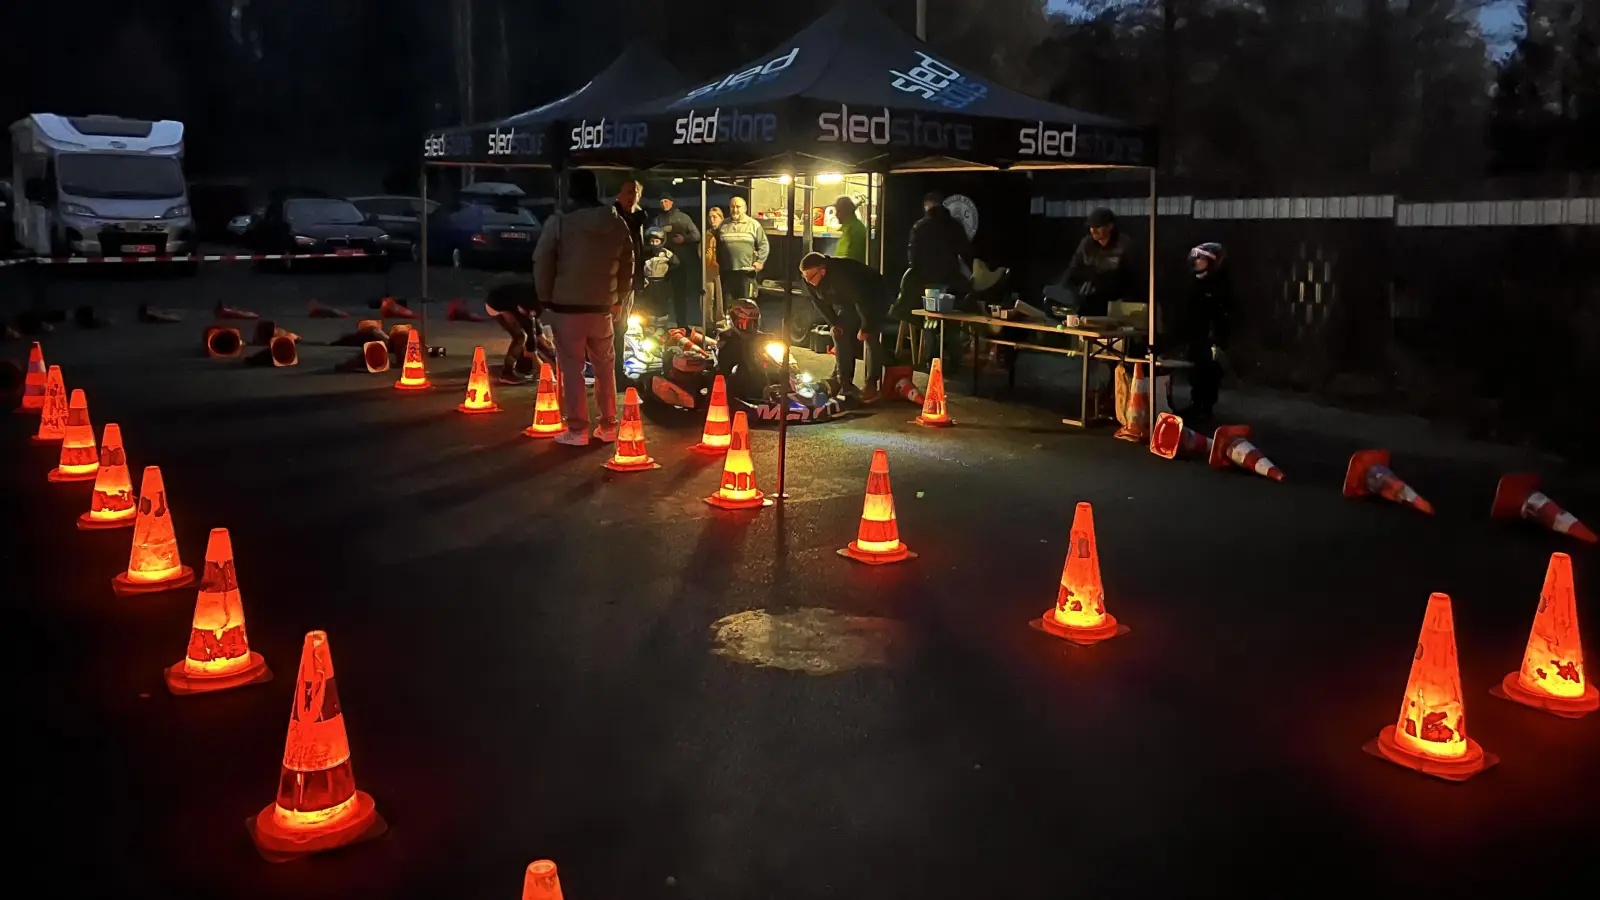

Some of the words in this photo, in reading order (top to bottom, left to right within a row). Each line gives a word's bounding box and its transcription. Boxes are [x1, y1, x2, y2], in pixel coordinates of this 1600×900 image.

[677, 47, 800, 102] sled
[889, 50, 960, 99] sled
[673, 107, 777, 144] sledstore
[817, 104, 974, 151] sledstore
